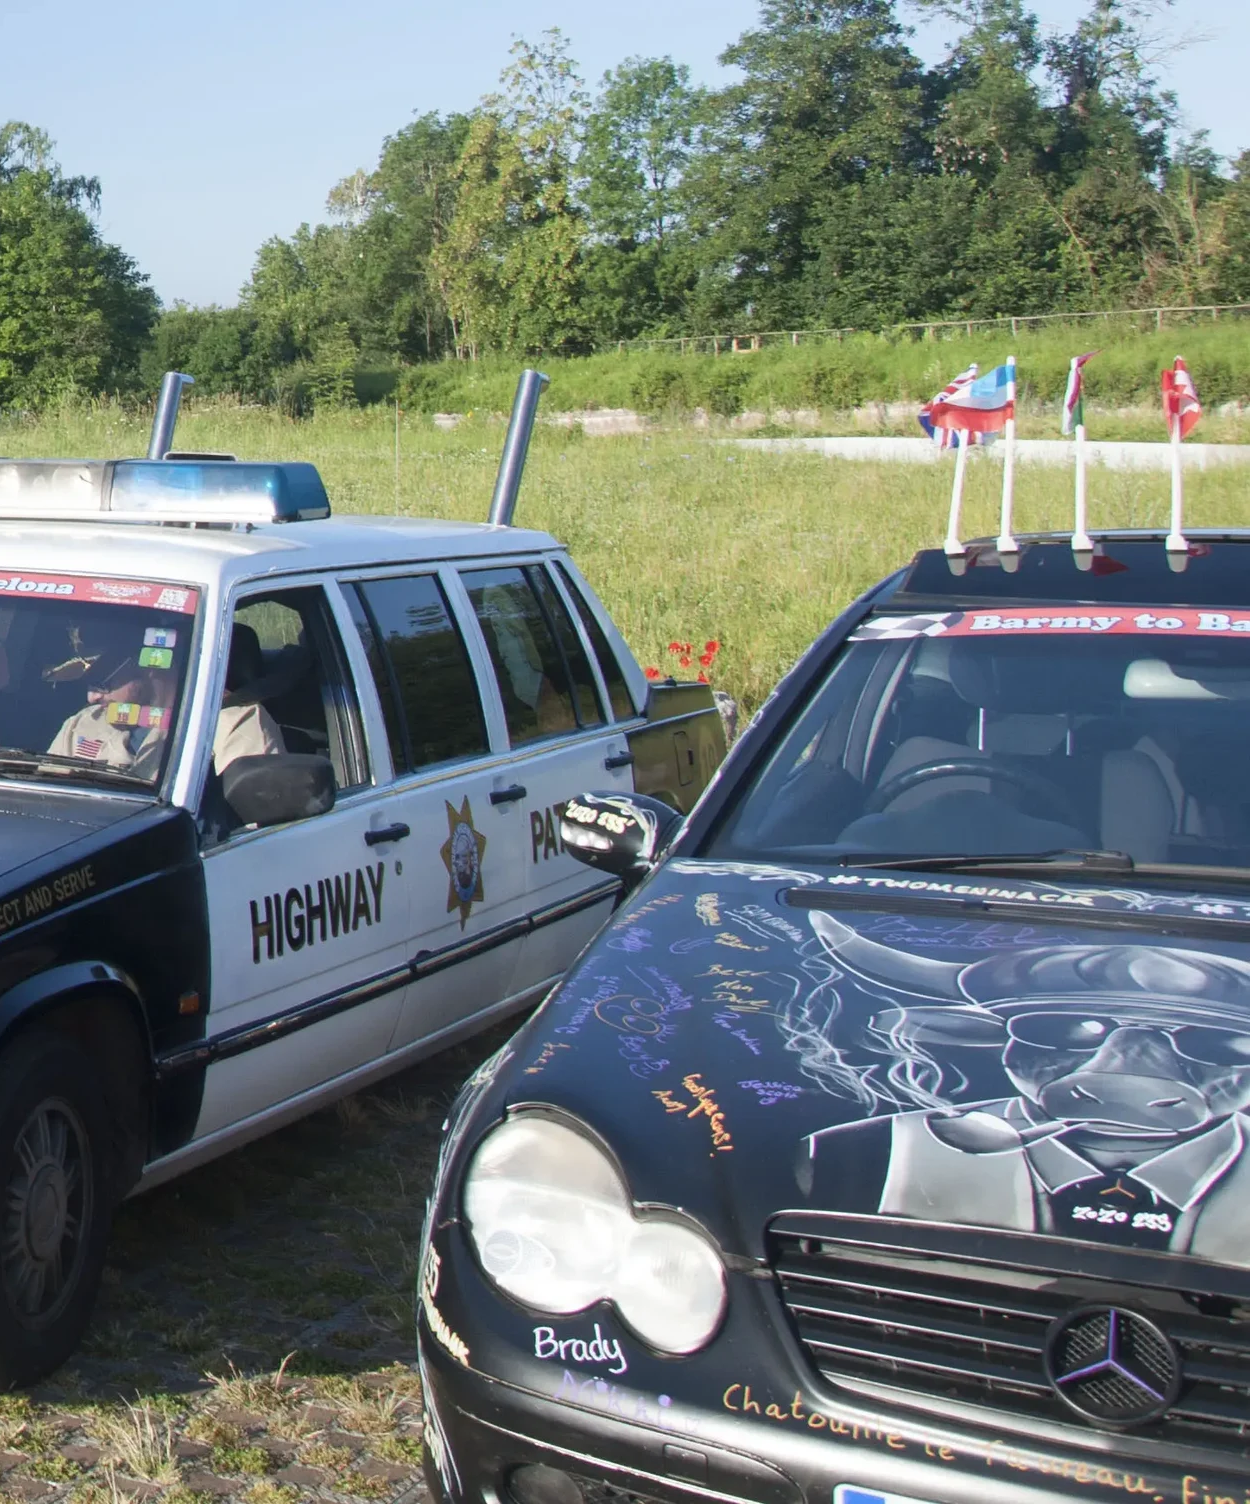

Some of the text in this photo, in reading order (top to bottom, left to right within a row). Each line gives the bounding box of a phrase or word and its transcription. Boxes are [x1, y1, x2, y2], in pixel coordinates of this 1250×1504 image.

[970, 614, 1122, 631] Barmy
[1134, 613, 1184, 629] to
[24, 886, 53, 917] AND
[53, 865, 96, 901] SERVE
[249, 862, 385, 965] HIGHWAY
[533, 1323, 627, 1374] Brady
[723, 1383, 905, 1449] Chatouille
